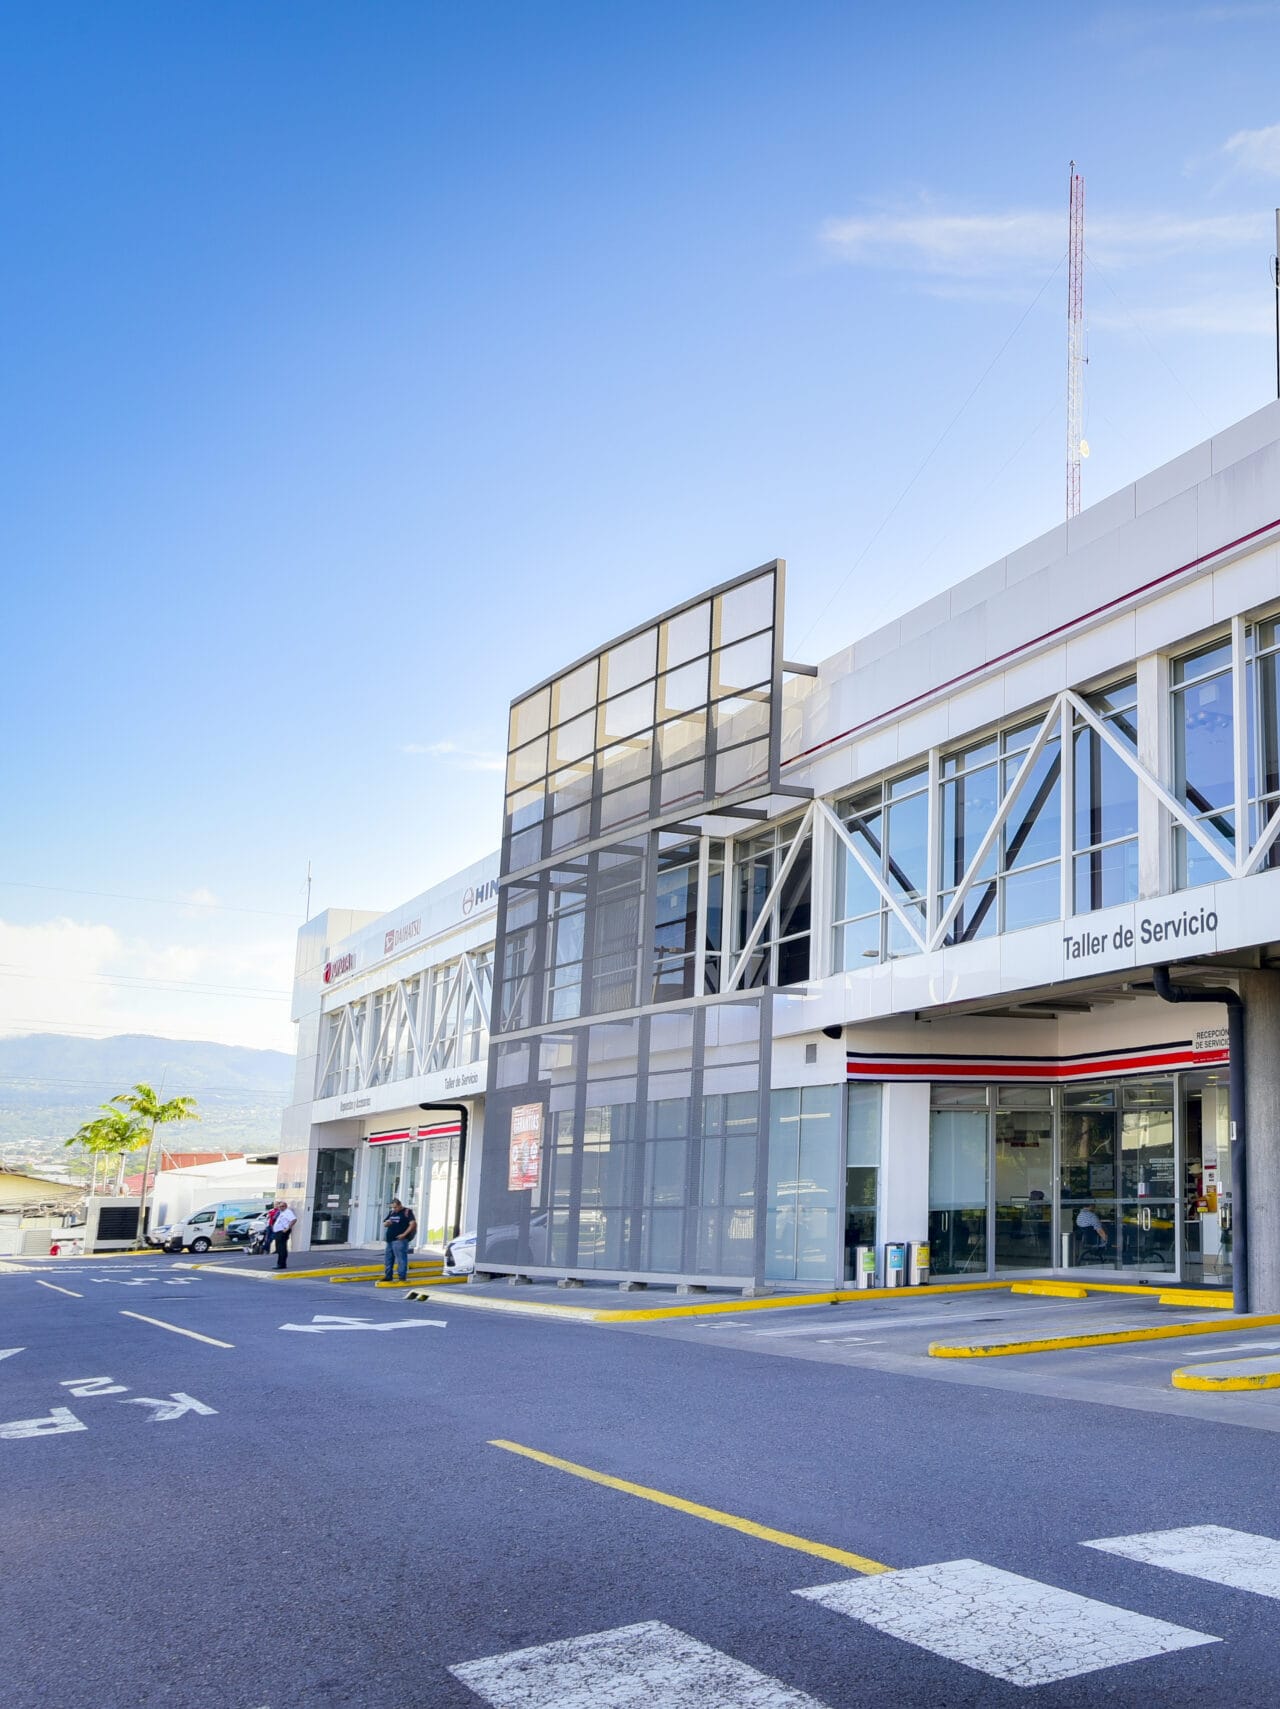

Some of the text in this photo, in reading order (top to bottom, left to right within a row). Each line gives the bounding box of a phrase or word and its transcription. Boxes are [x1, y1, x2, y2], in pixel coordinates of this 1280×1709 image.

[1063, 907, 1218, 960] Taller de Servicio
[1195, 1041, 1204, 1050] DE
